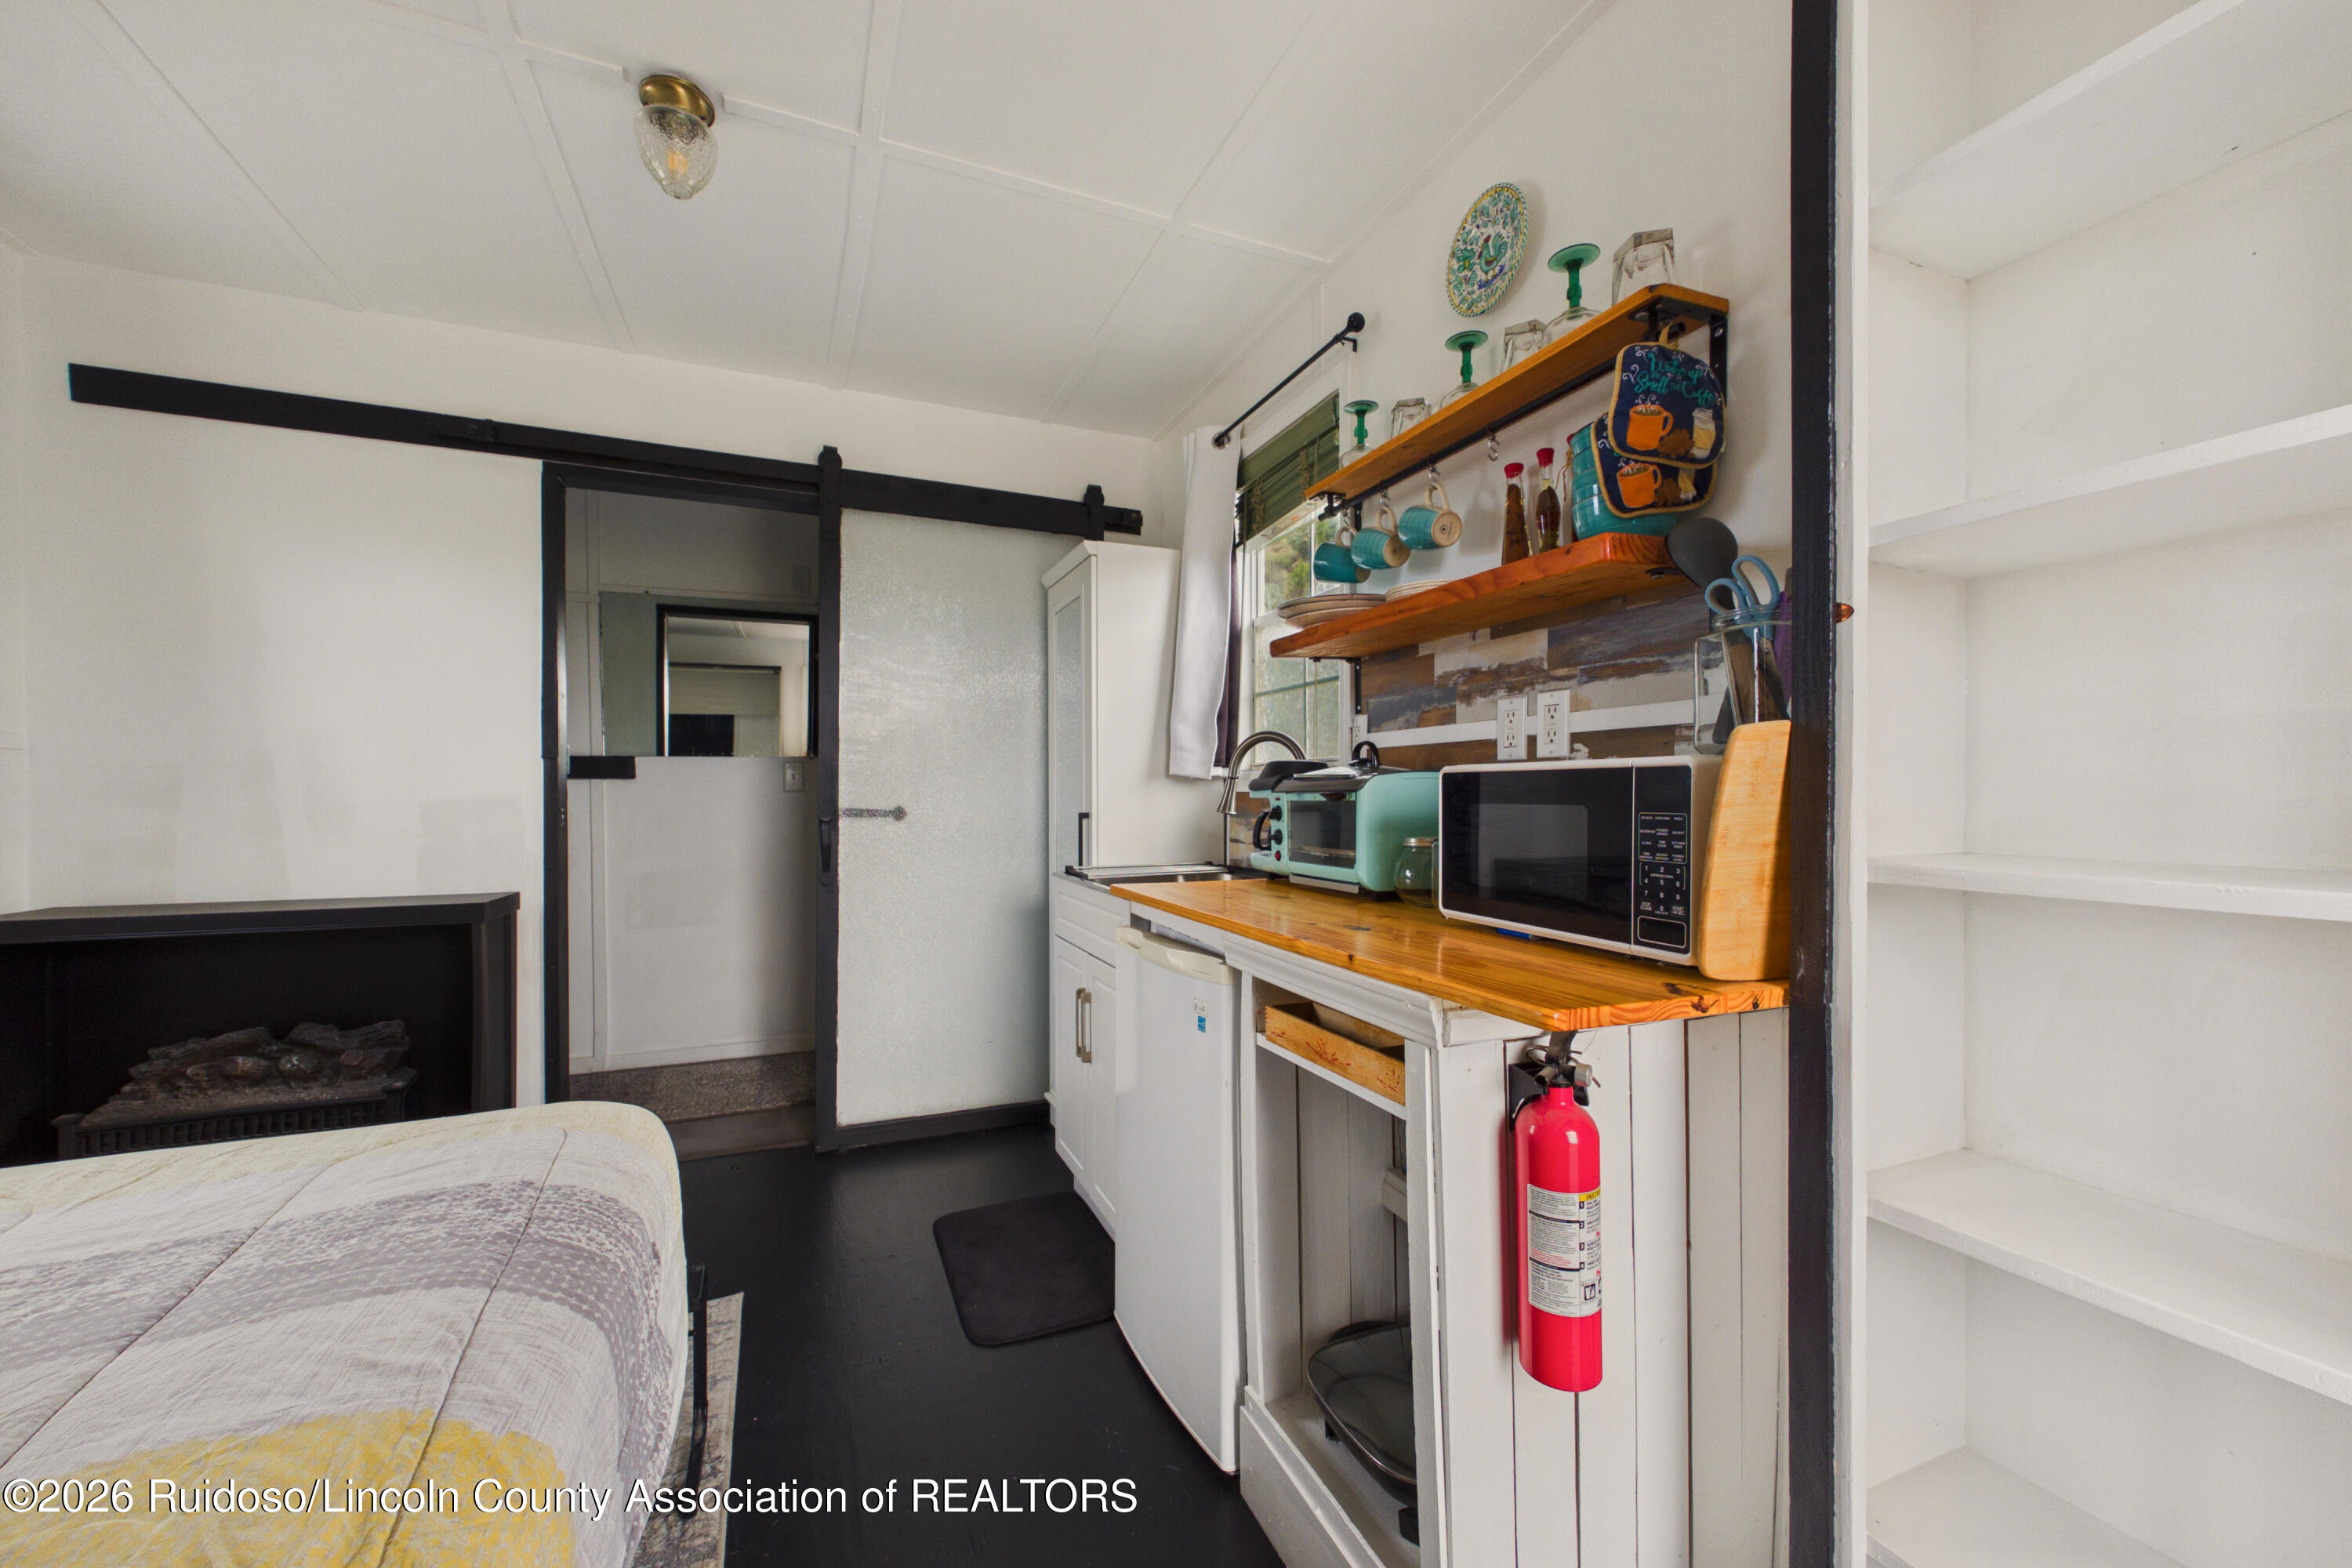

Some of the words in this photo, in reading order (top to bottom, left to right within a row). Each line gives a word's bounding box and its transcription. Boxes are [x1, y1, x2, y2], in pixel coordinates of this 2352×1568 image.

[1635, 370, 1668, 394] Smell
[1648, 352, 1686, 376] Wake
[1688, 368, 1703, 384] up
